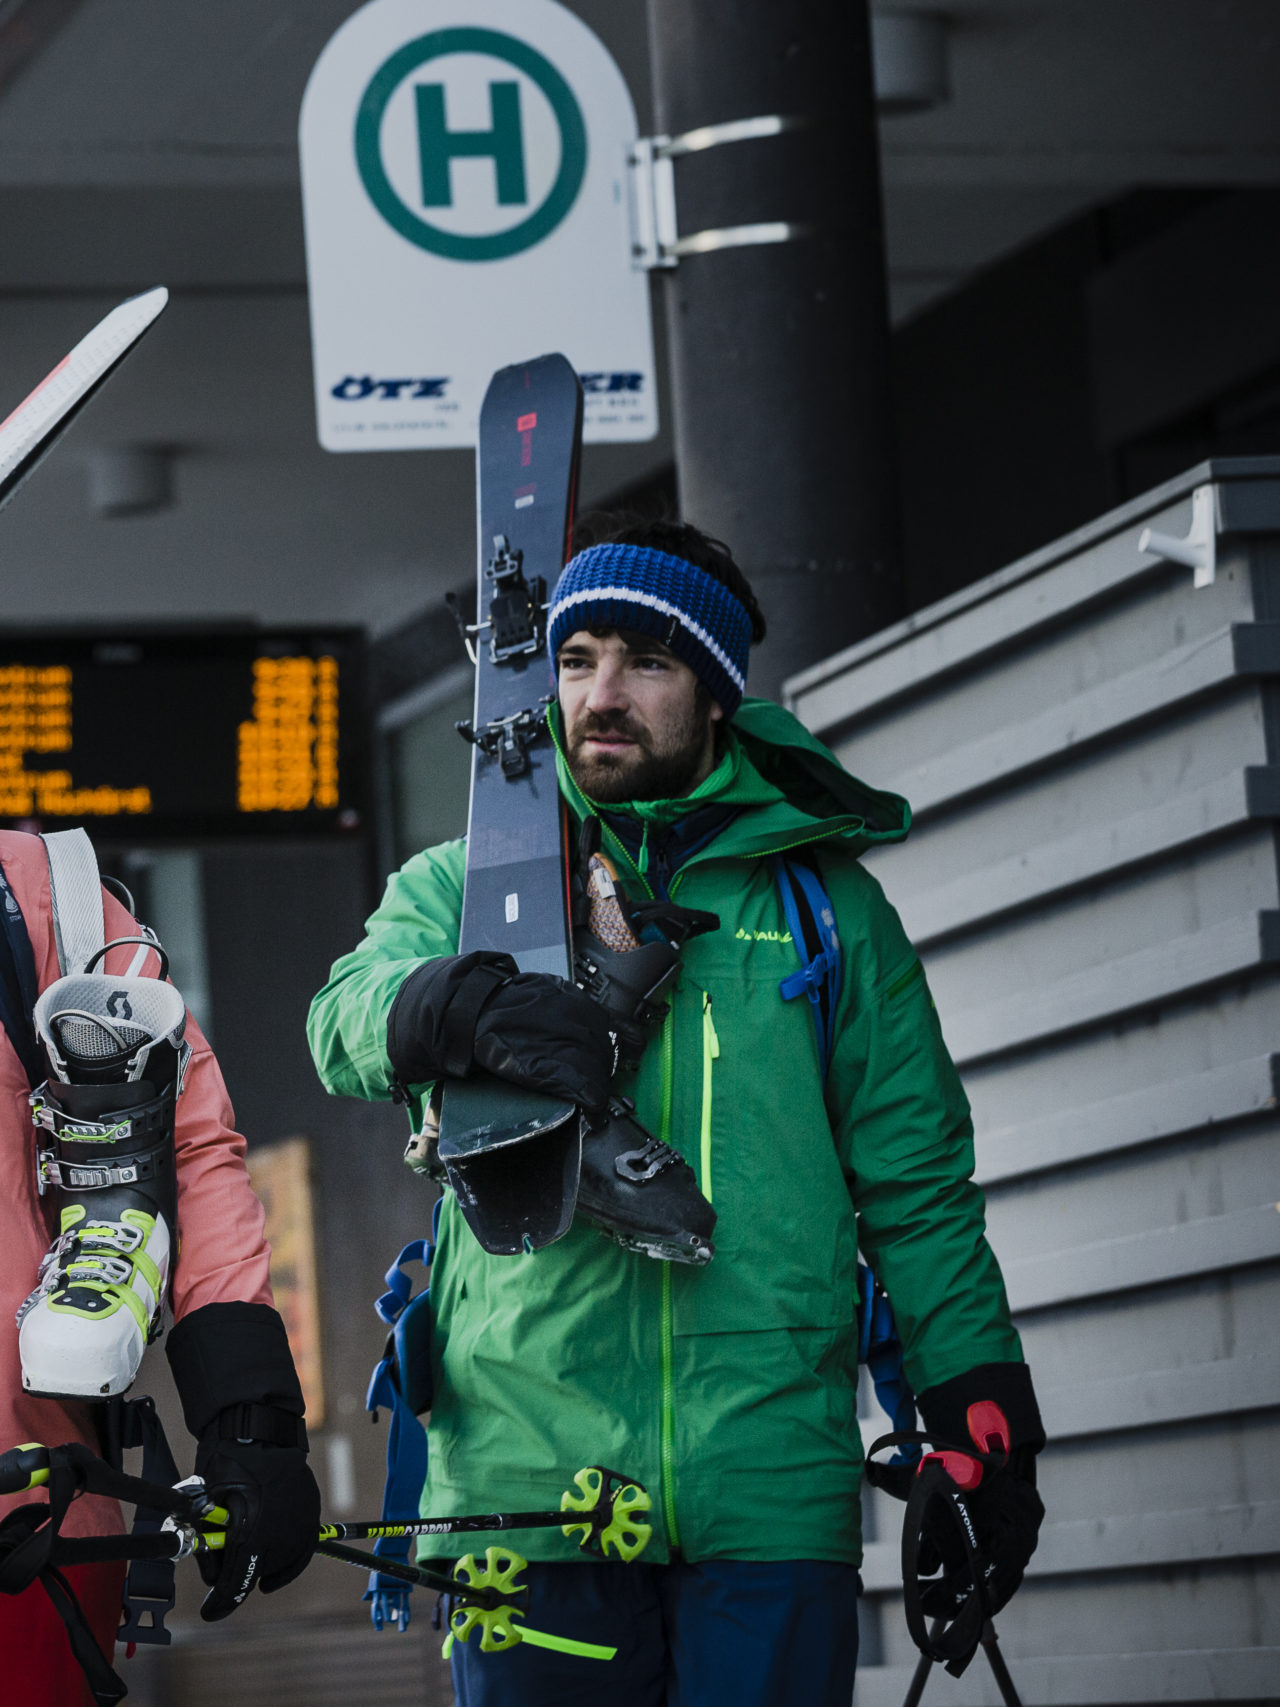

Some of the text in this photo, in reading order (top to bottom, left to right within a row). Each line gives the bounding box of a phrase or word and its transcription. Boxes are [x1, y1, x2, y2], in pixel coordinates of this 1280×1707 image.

[414, 80, 528, 208] H
[956, 1502, 978, 1549] ATOMIC
[240, 1554, 259, 1590] VAUDE
